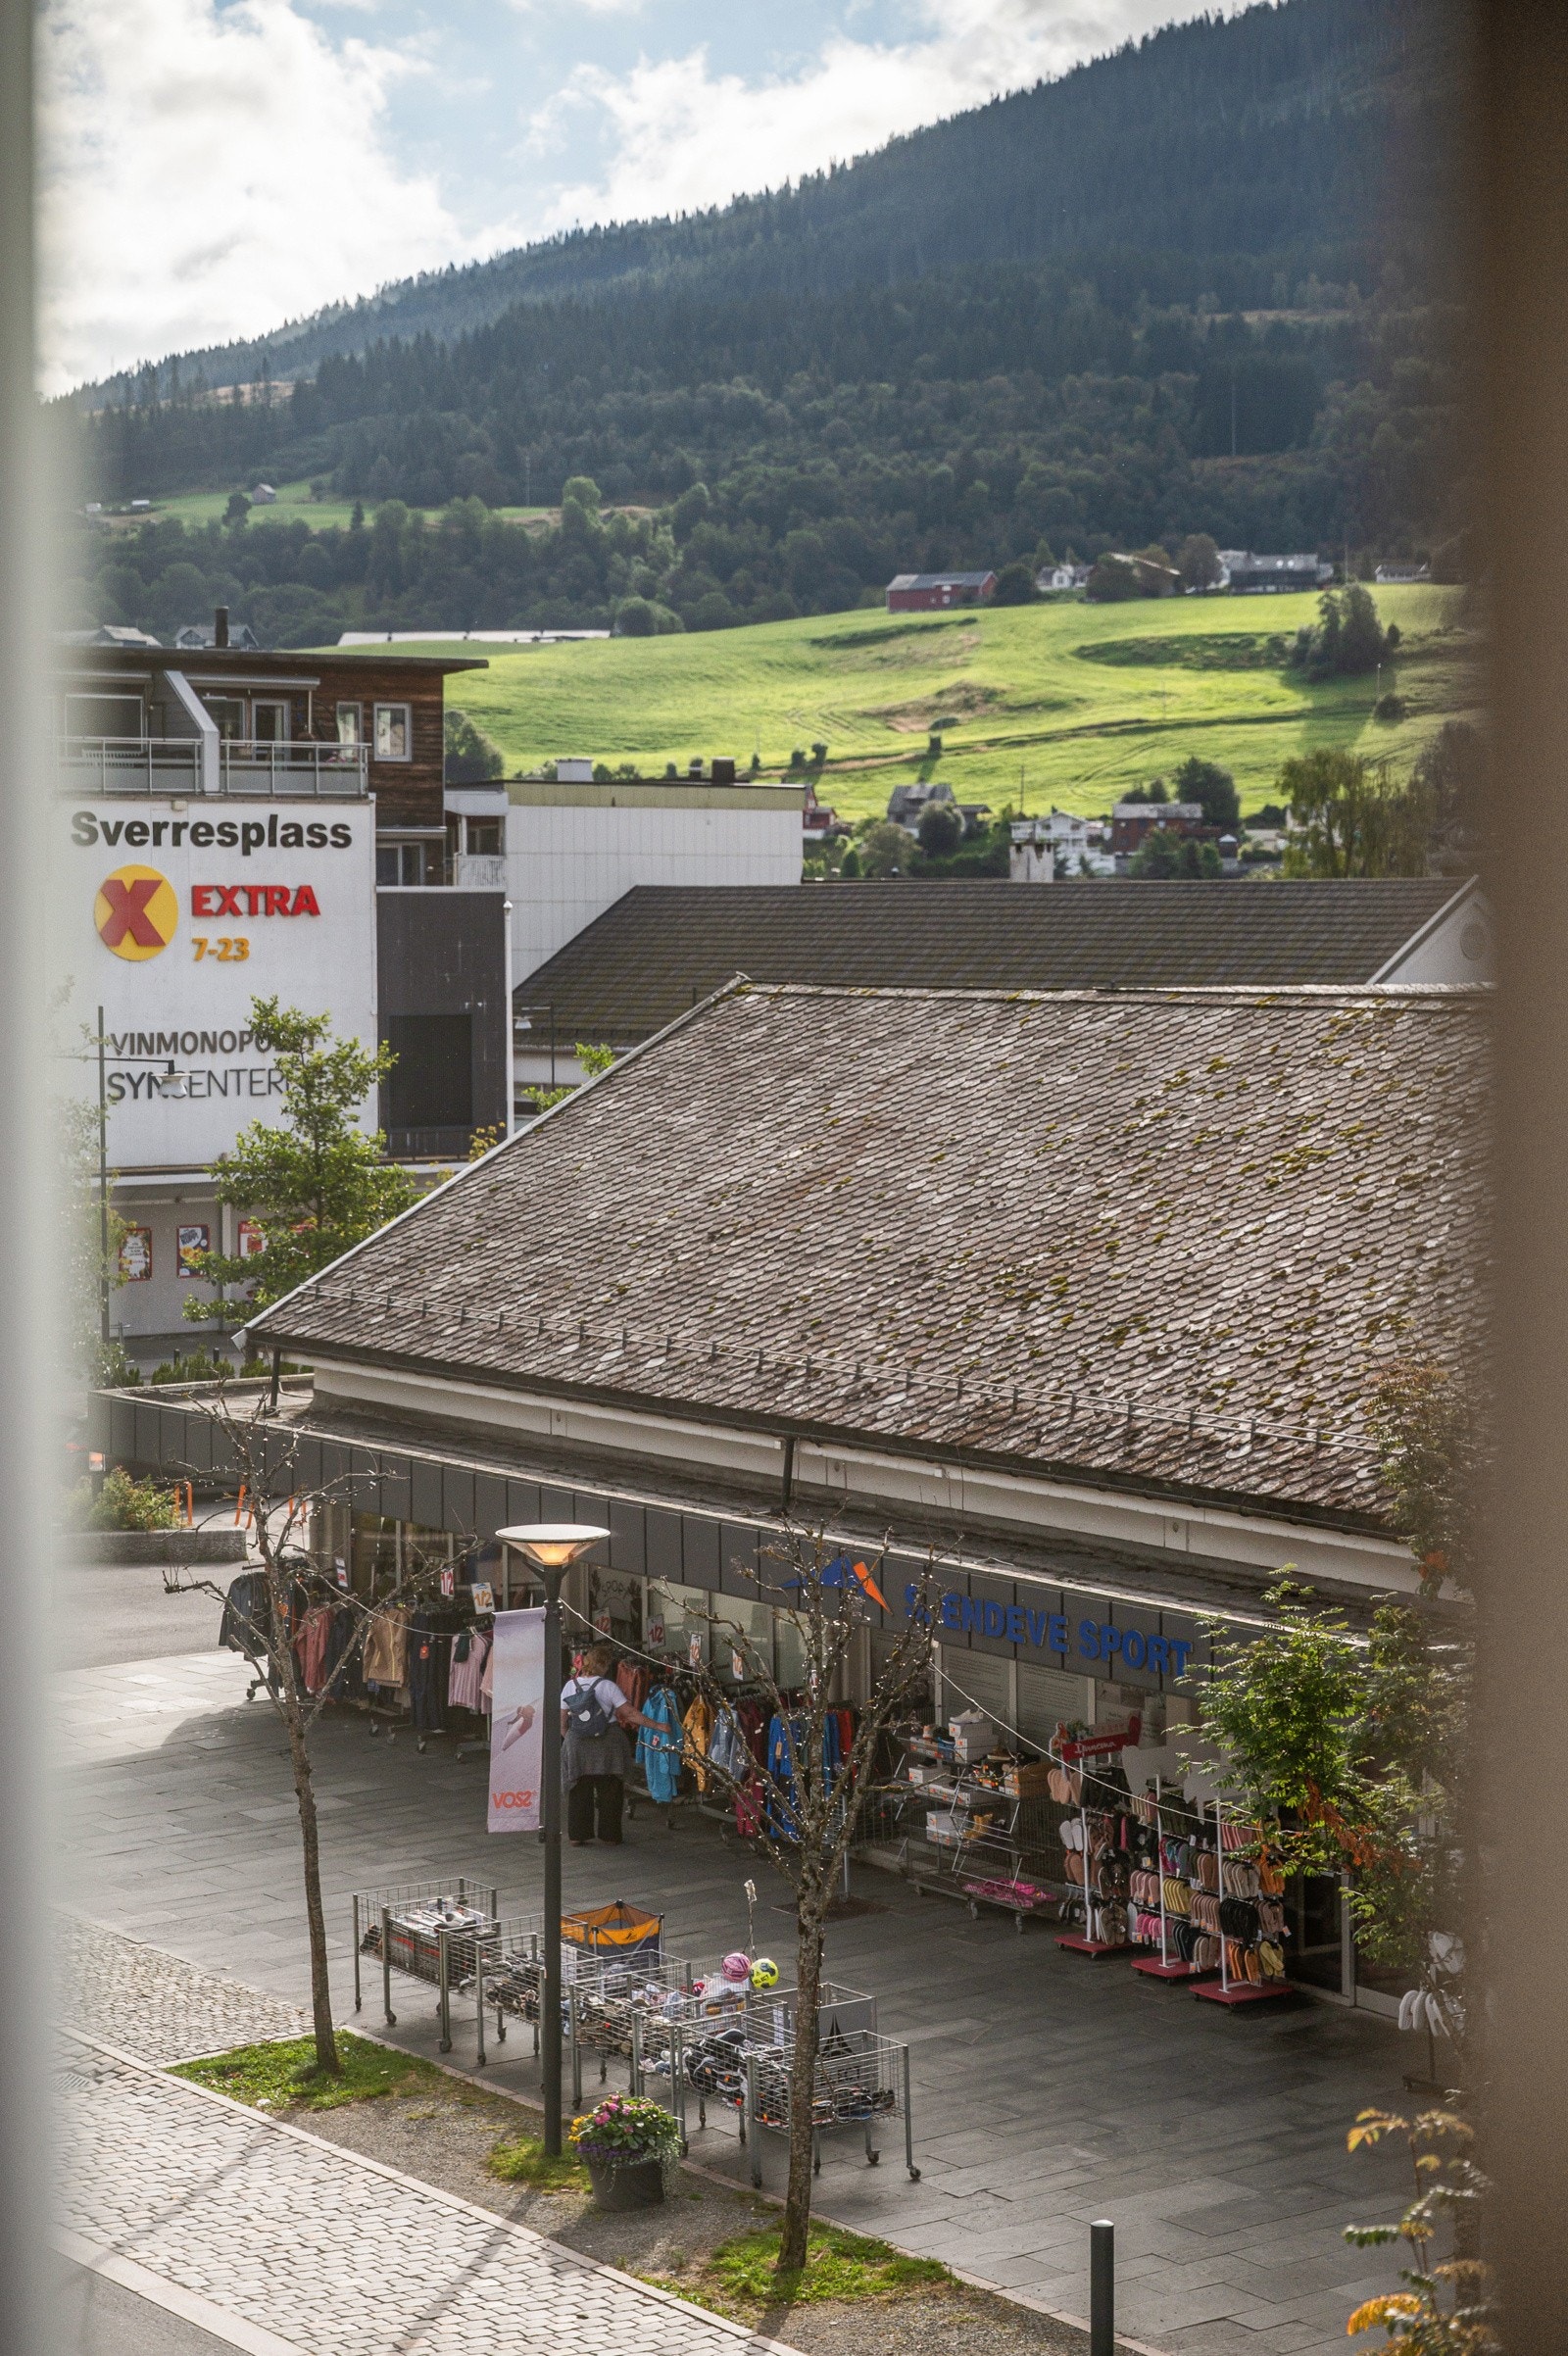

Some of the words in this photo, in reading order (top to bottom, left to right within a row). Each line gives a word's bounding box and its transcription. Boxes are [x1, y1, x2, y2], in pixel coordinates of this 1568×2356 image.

[71, 810, 353, 857] Sverresplass
[100, 879, 166, 947] X
[191, 885, 321, 916] EXTRA
[192, 938, 250, 962] 7-23
[904, 1584, 1069, 1654] SENDEVE
[1078, 1619, 1194, 1678] SPORT
